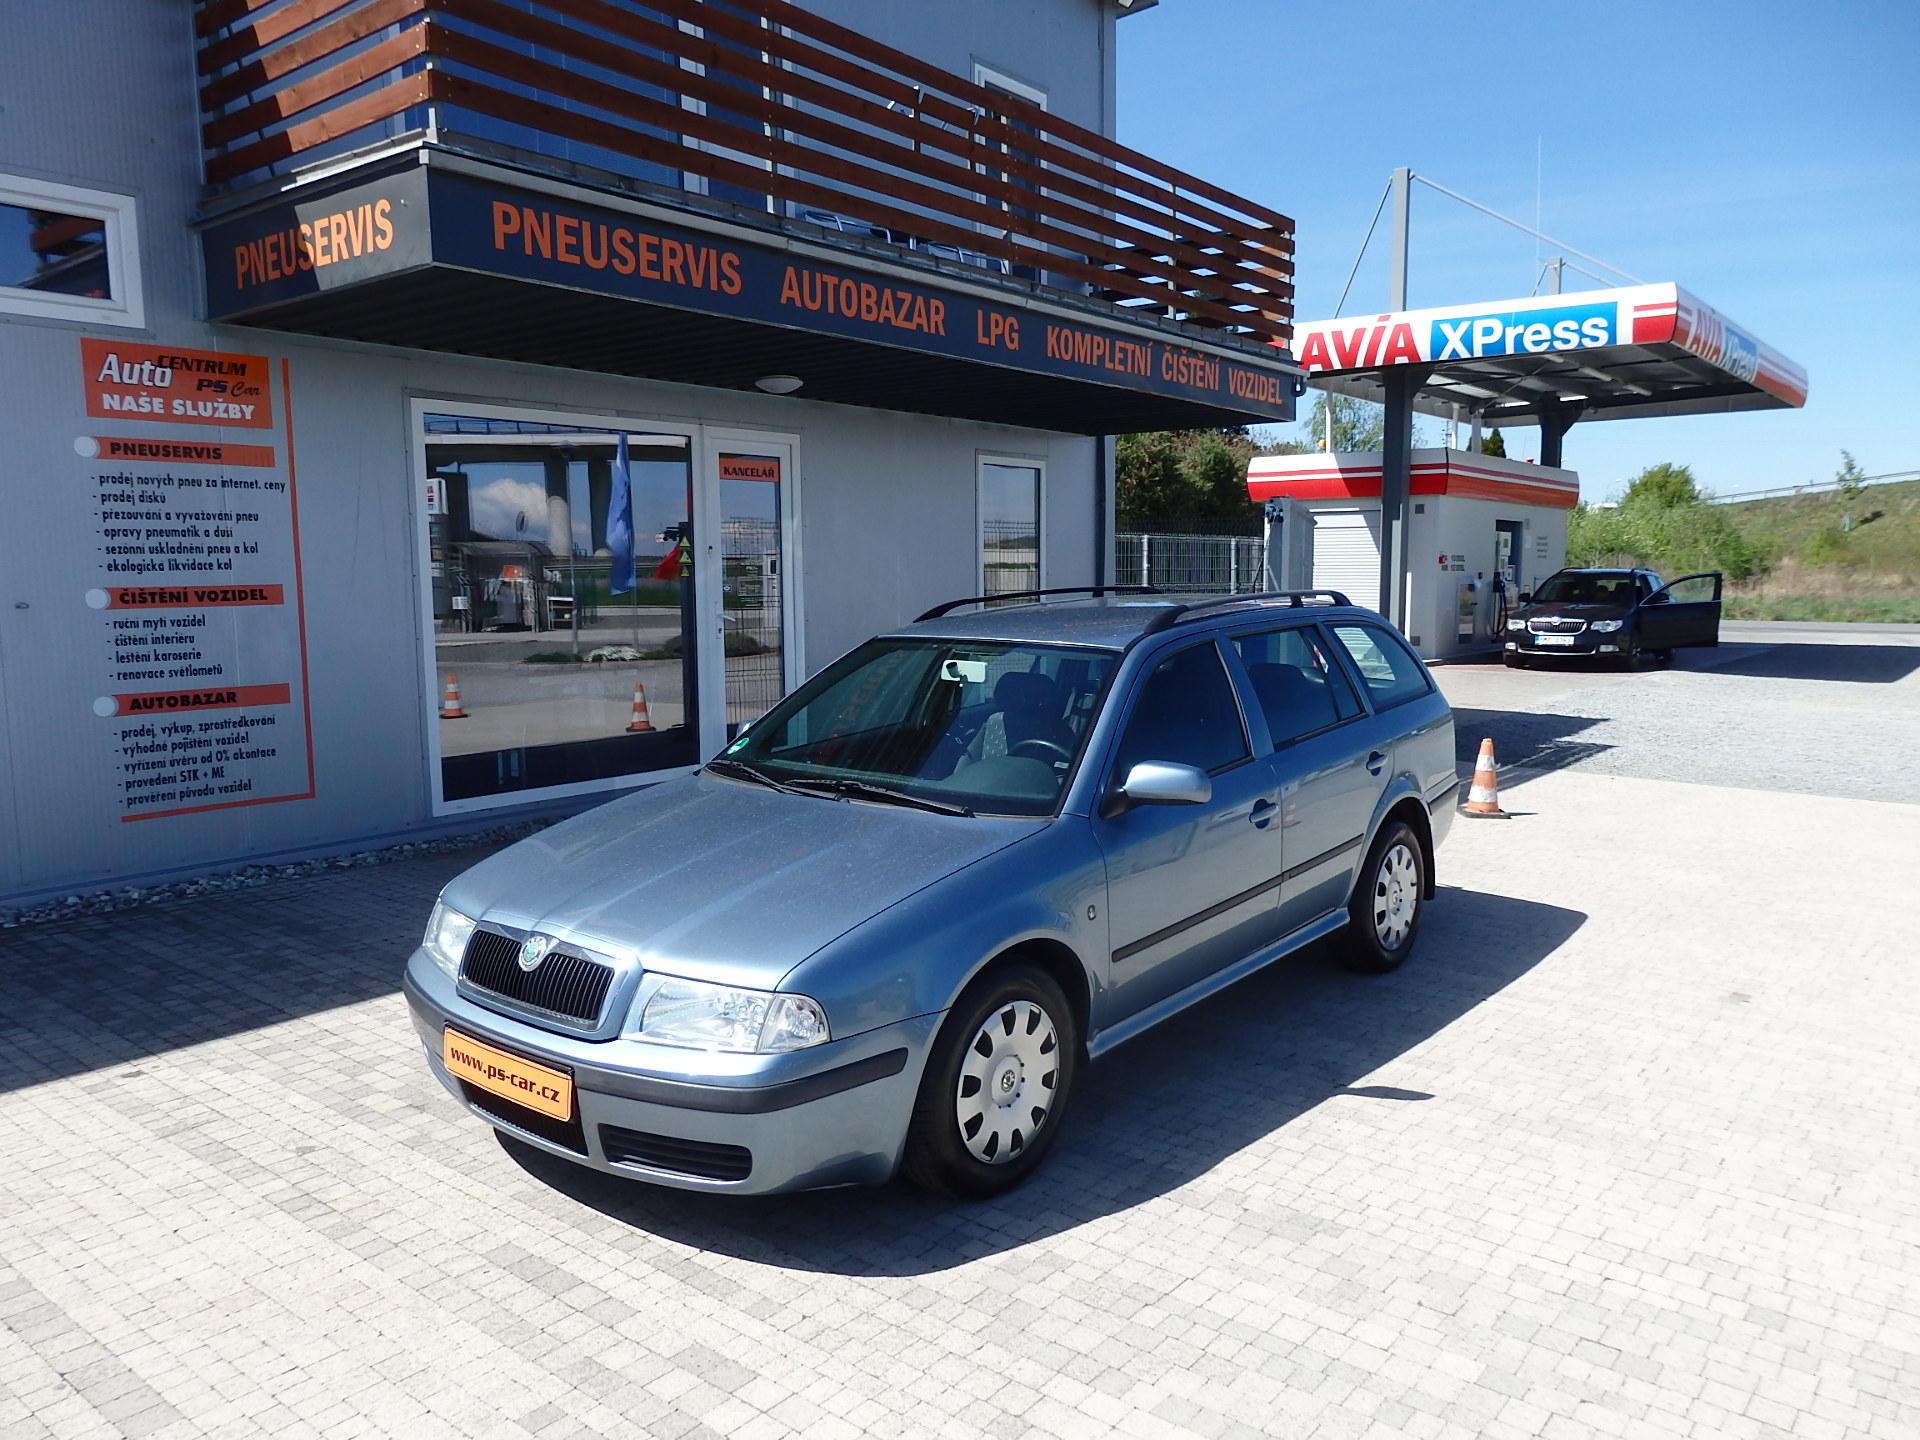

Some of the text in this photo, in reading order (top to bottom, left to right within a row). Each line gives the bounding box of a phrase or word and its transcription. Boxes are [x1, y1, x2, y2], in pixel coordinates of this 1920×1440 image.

[235, 199, 394, 289] PNEUSERVIS
[492, 200, 1283, 405] PNEUSERVIS AUTOBAZAR LPG KOMPLETNÍ ČIŠTĚNÍ VOZIDEL
[1299, 314, 1609, 371] AVIA XPress
[97, 352, 172, 388] Auto
[158, 354, 247, 376] CENTRUM
[196, 378, 261, 397] PS Car
[102, 391, 255, 419] NAŠE SLUŽBY
[110, 442, 222, 459] PNEUSERVIS
[99, 472, 133, 488] prodej
[137, 473, 174, 488] nových
[178, 477, 202, 489] pneu
[206, 478, 217, 488] za
[221, 475, 261, 490] internet.
[264, 481, 286, 494] ceny
[101, 489, 135, 506] prodej
[102, 508, 162, 523] přezouvání
[165, 512, 171, 520] a
[236, 513, 259, 524] pneu
[104, 528, 142, 540] opravy
[145, 525, 200, 540] pneumatik
[204, 529, 210, 537] a
[207, 545, 231, 557] pneu
[234, 545, 240, 554] a
[243, 541, 259, 554] kol
[107, 558, 165, 575] ekologická
[168, 558, 213, 571] likvidace
[217, 558, 232, 571] kol
[120, 587, 268, 604] ČIŠTĚNÍ VOZIDEL
[170, 614, 206, 628] vozidel
[153, 648, 202, 661] karoserie
[117, 669, 165, 681] renovace
[129, 691, 237, 711] AUTOBAZAR
[215, 731, 249, 746] vozidel
[201, 751, 212, 764] od
[216, 748, 230, 761] 0%
[125, 772, 177, 792] provedení
[180, 768, 200, 783] STK
[211, 766, 225, 779] ME
[179, 784, 215, 802] původu
[218, 778, 252, 794] vozidel
[450, 1048, 560, 1103] www.ps-car.cz
